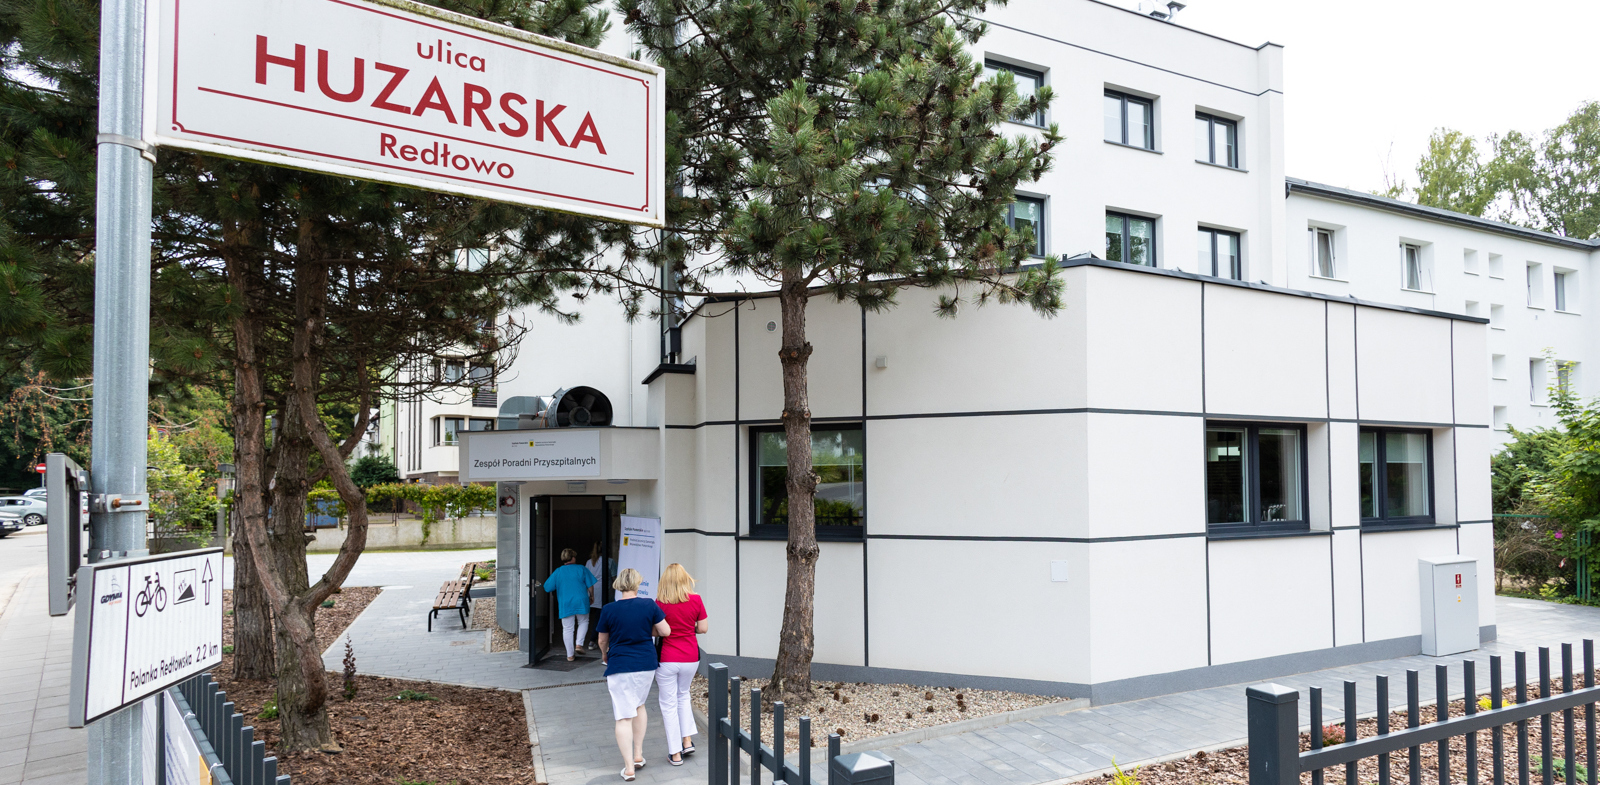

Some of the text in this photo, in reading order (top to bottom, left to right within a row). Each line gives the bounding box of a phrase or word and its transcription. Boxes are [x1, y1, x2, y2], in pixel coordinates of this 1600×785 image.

[416, 39, 487, 74] ulica
[254, 34, 609, 157] HUZARSKA
[380, 132, 516, 180] Redłowo
[474, 456, 597, 470] Zespół Poradni Przyszpitalnych
[130, 642, 219, 690] Polanka Redłowska 2,2 km
